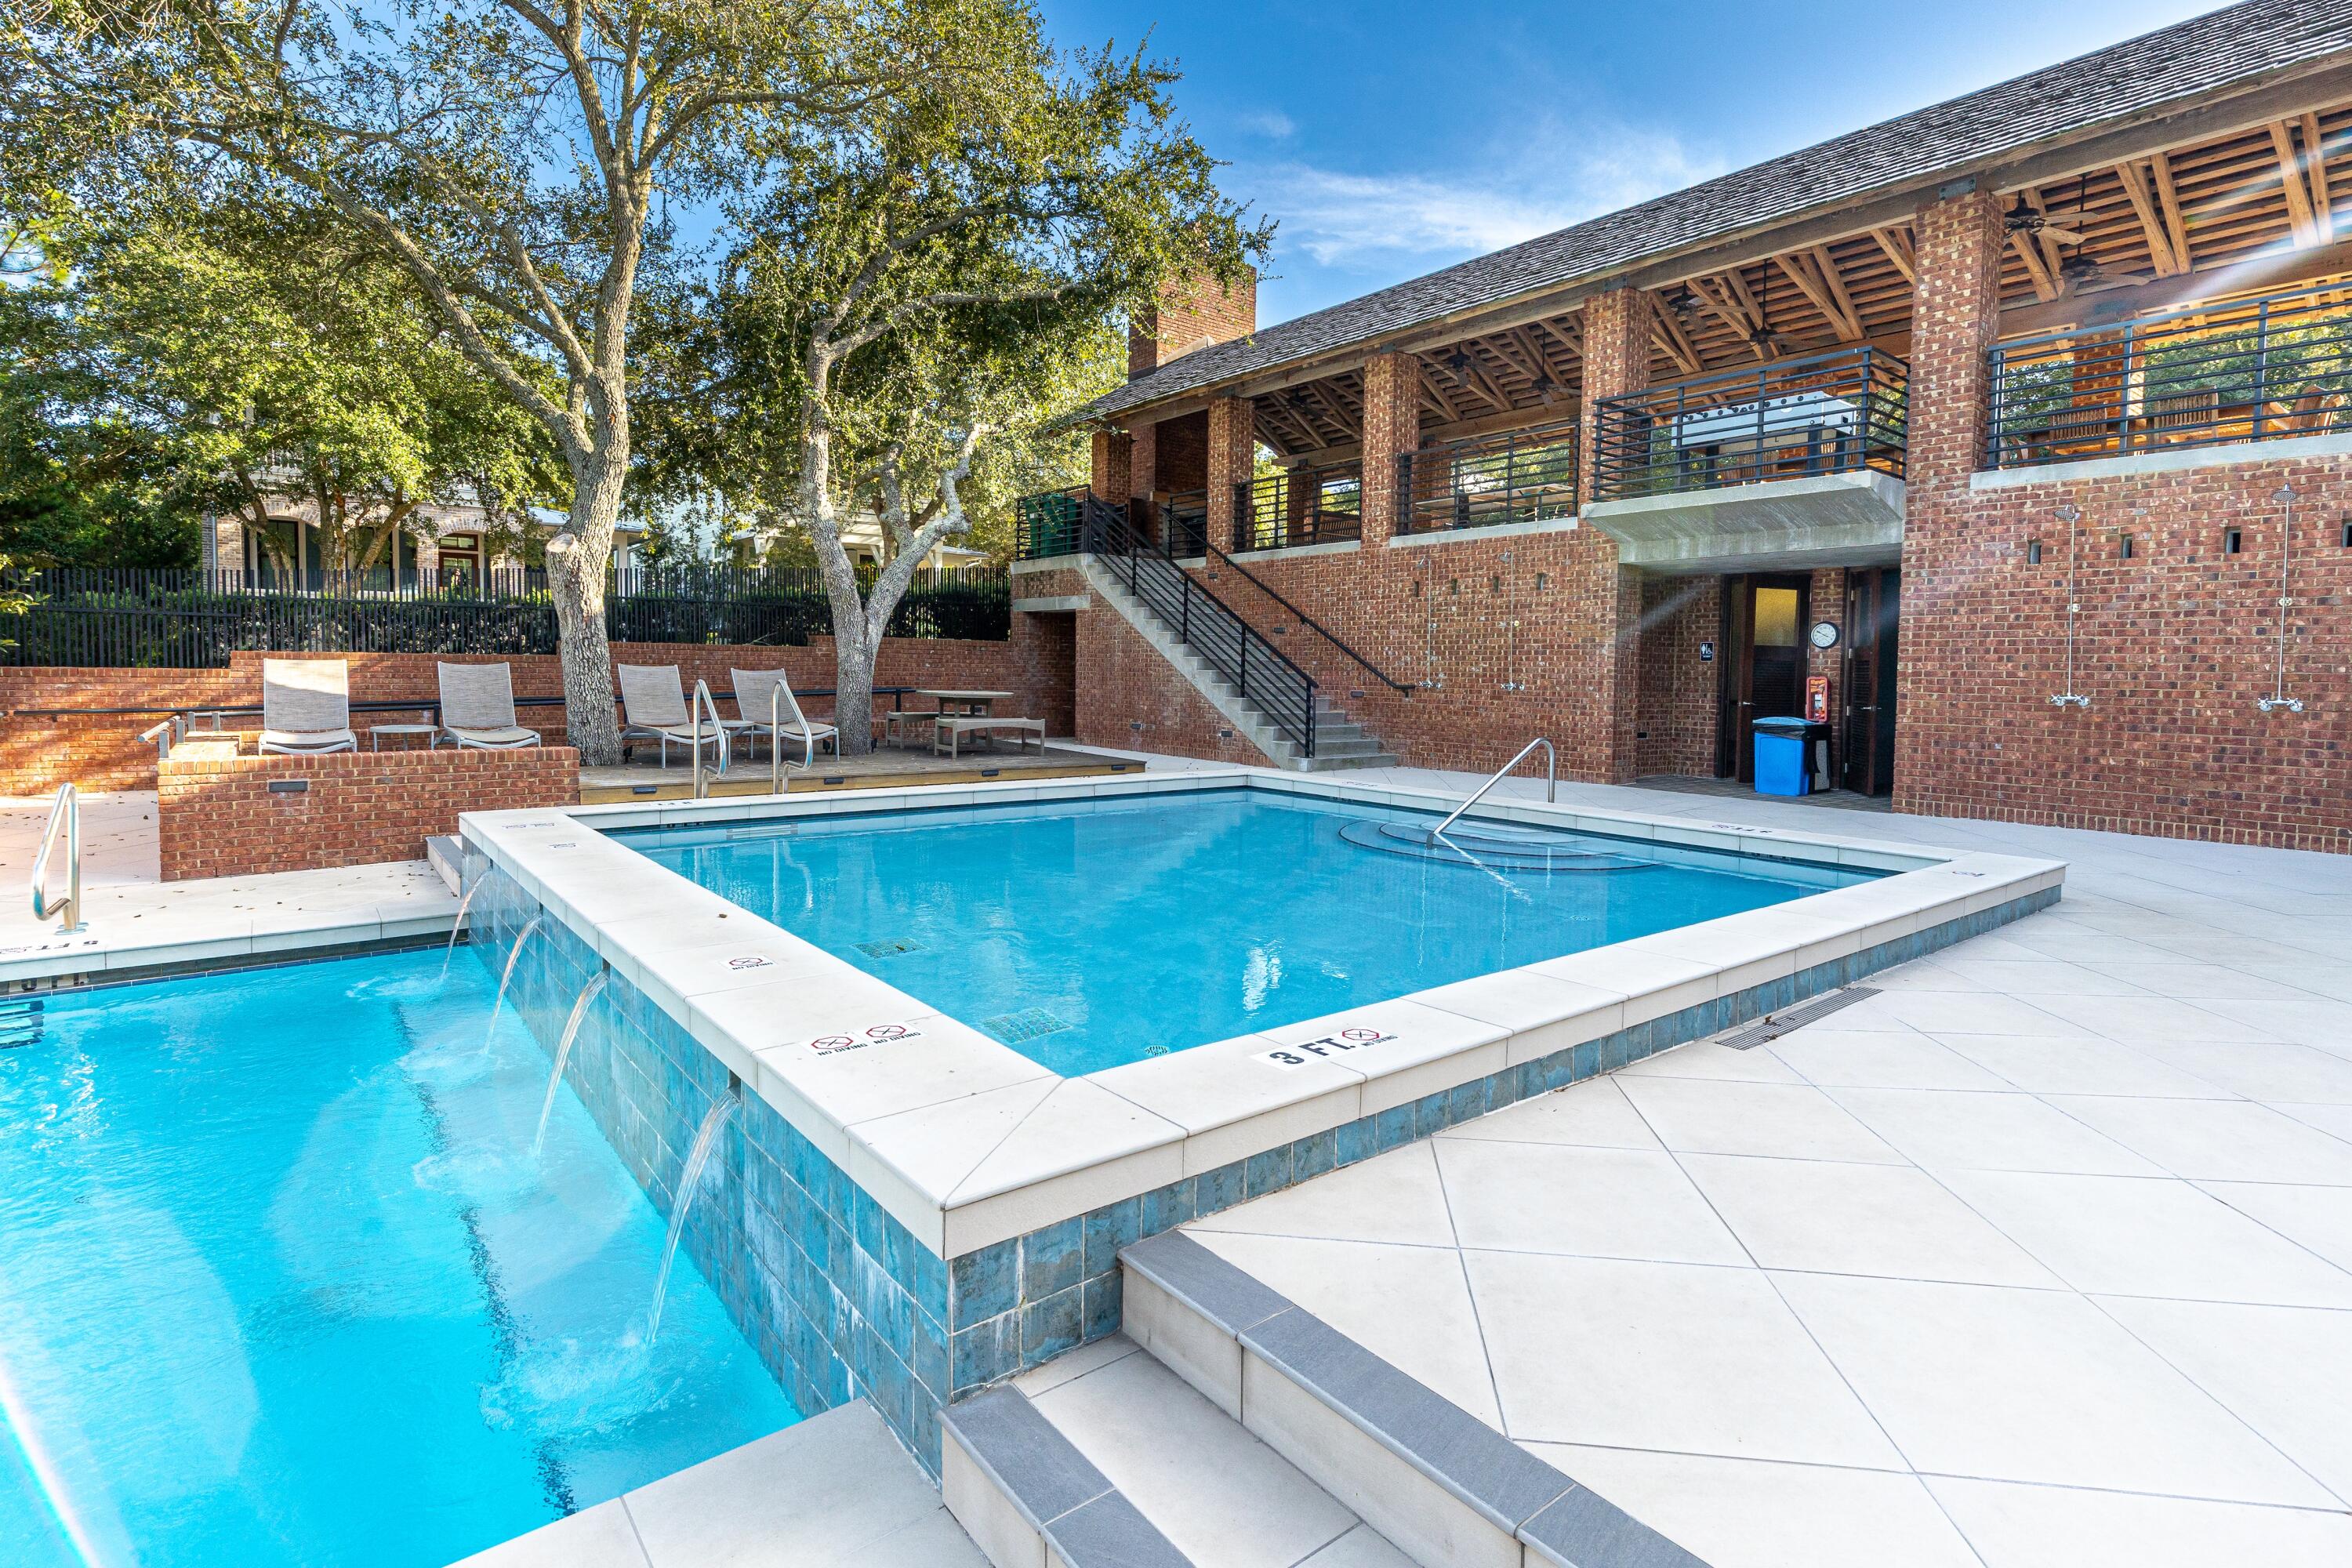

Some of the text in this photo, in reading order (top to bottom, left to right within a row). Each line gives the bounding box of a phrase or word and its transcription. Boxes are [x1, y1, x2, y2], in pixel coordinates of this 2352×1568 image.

[889, 1032, 921, 1041] DIVING
[834, 1043, 868, 1052] DIVING
[1269, 1037, 1356, 1065] 3 FT.
